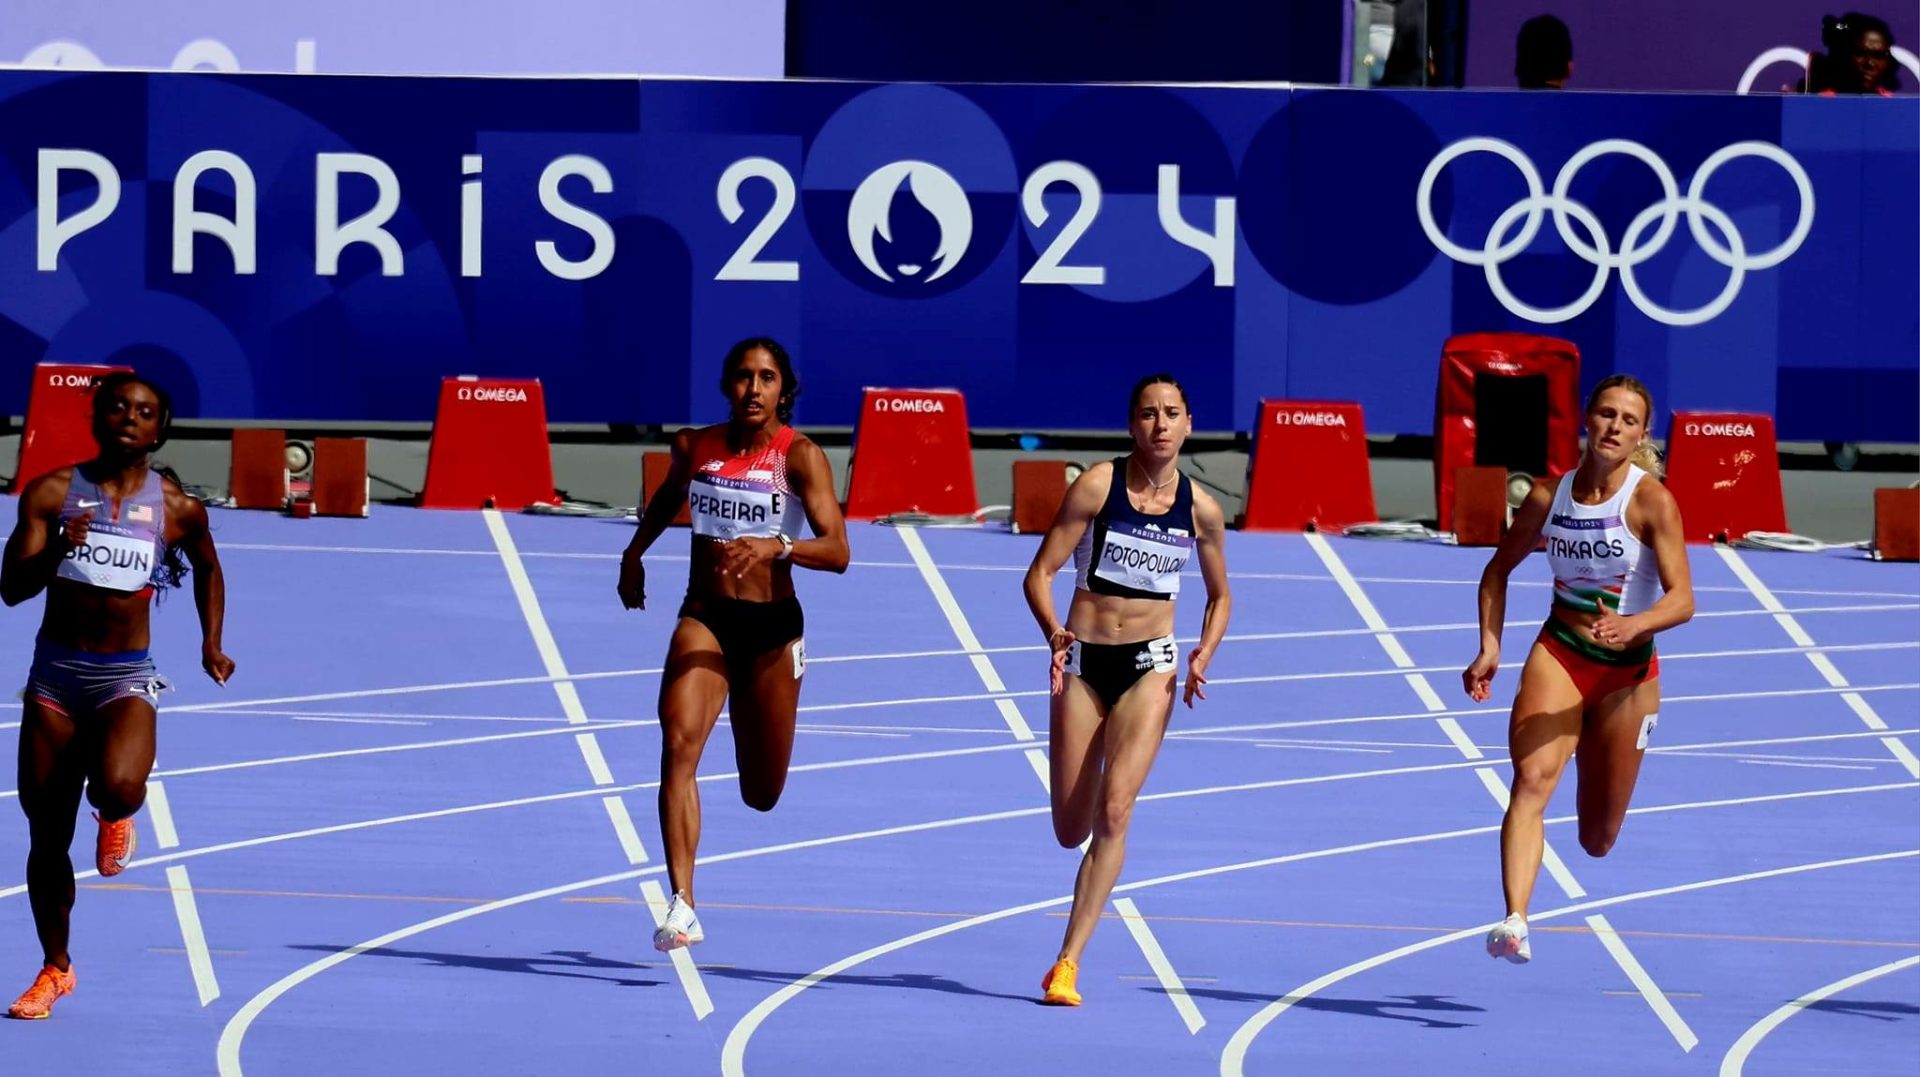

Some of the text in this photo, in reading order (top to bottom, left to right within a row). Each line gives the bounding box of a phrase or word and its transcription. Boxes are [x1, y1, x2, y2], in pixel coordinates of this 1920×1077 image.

[474, 386, 528, 402] OMEGA
[891, 398, 944, 413] OMEGA
[1292, 410, 1347, 427] OMEGA
[1701, 422, 1755, 437] OMEGA
[690, 493, 766, 522] PEREIRA
[1551, 536, 1625, 560] TAKACS
[1162, 643, 1174, 664] 5
